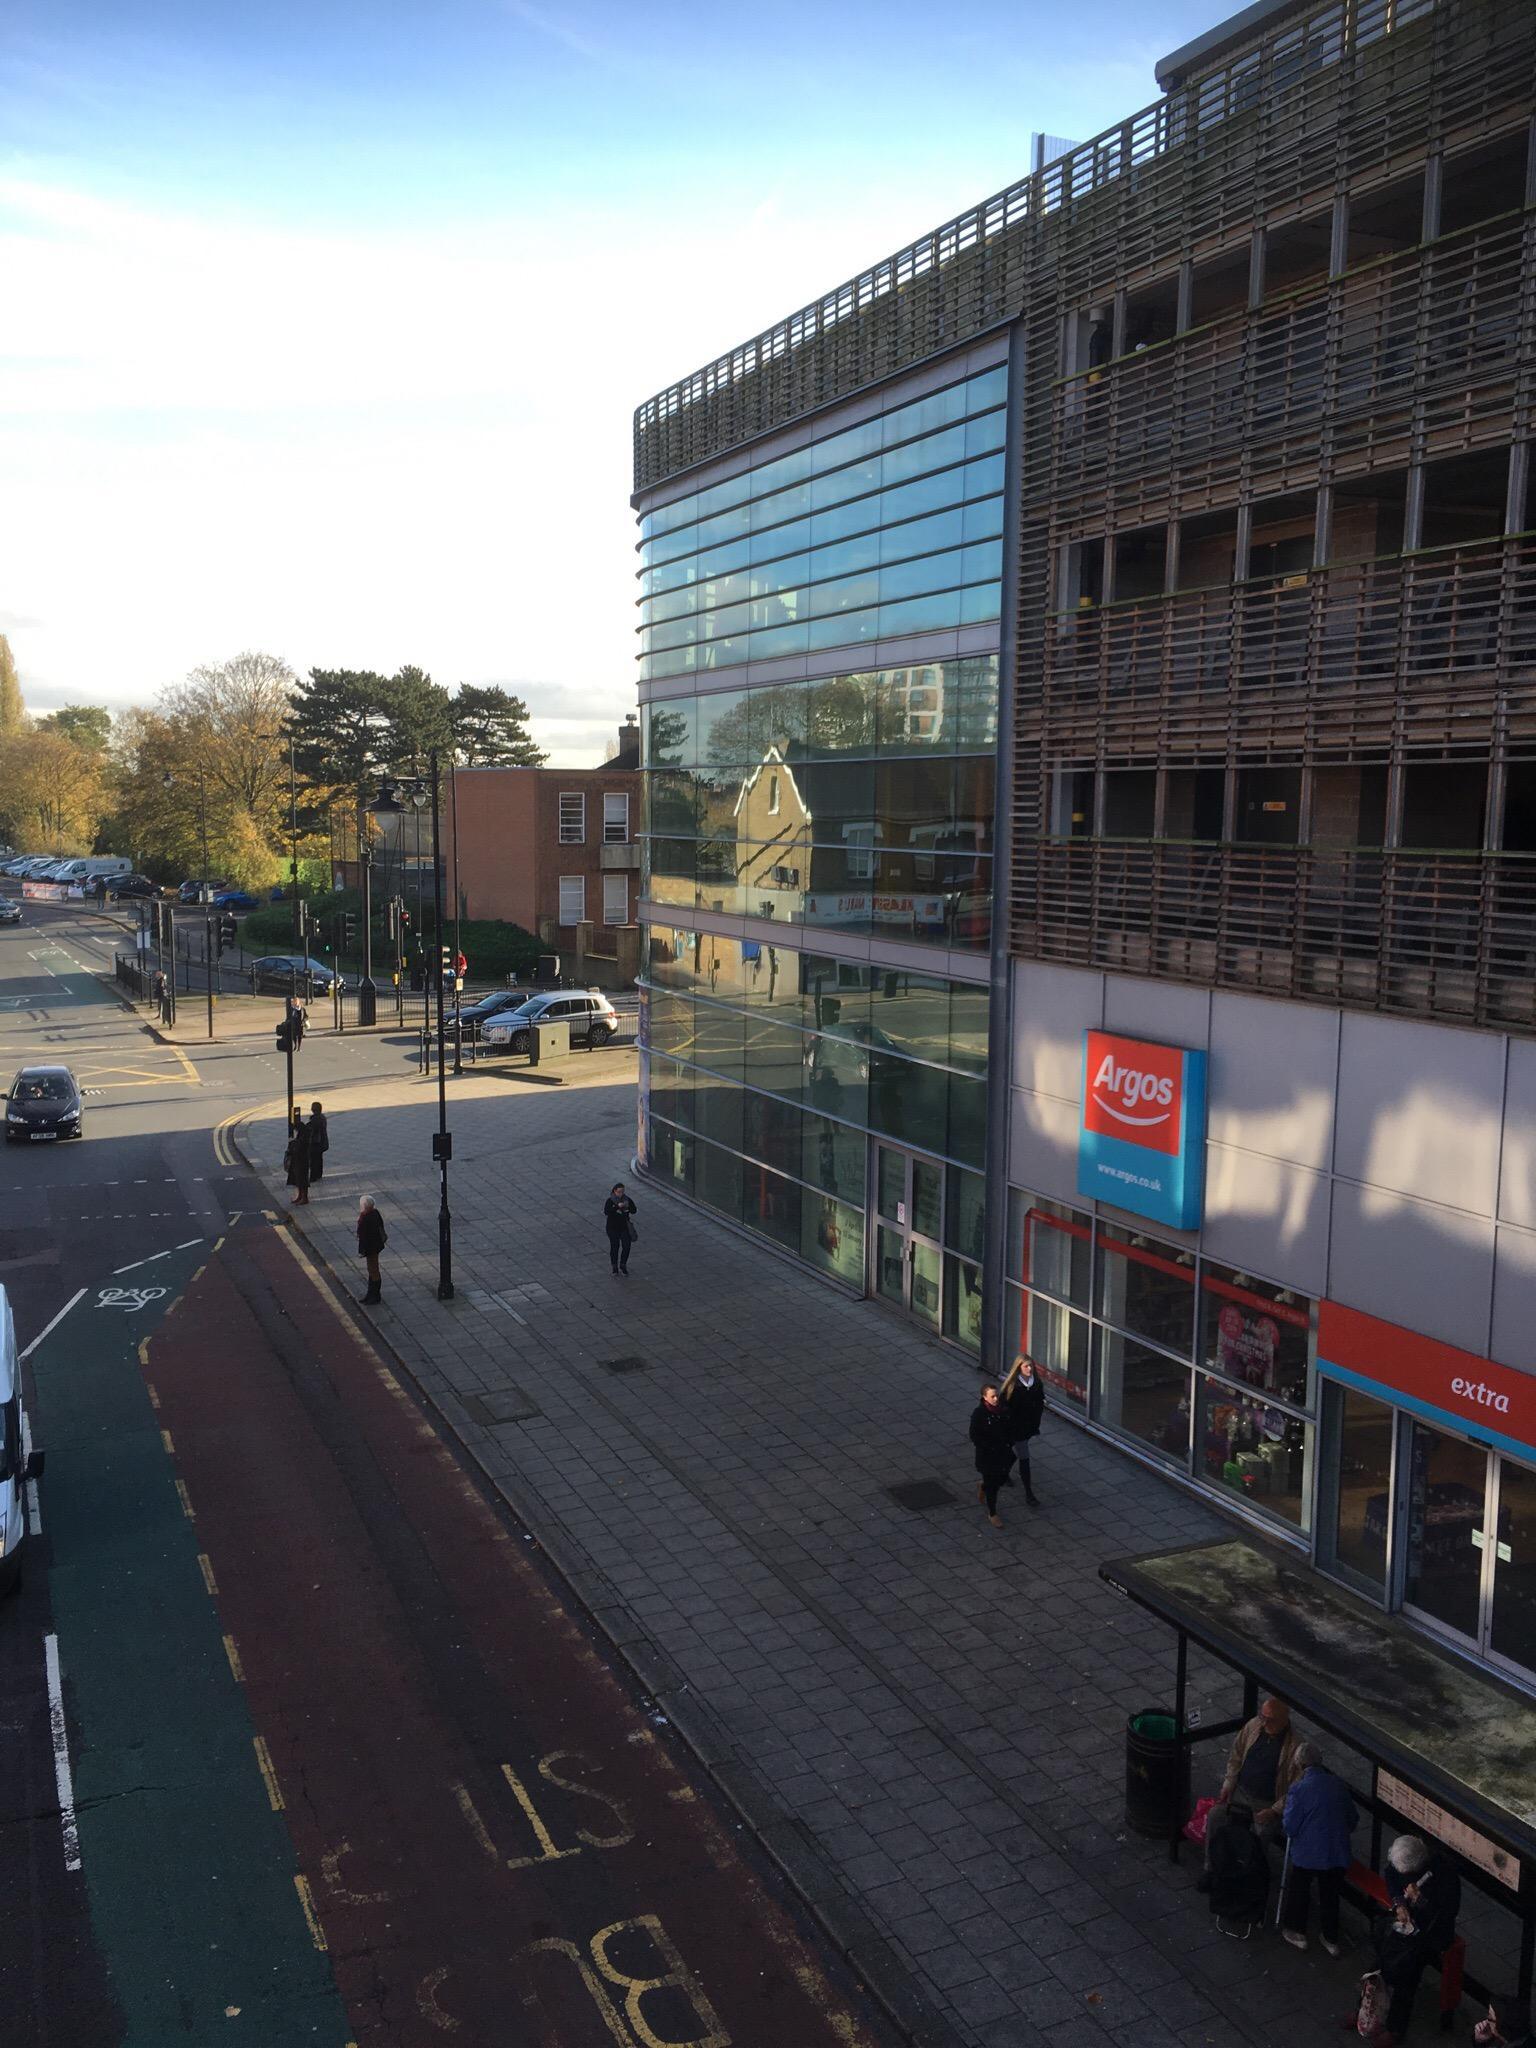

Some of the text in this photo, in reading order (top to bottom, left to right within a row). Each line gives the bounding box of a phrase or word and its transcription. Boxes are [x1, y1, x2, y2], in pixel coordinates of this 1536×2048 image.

[1093, 1055, 1174, 1108] Argos
[1097, 1163, 1162, 1192] www.argos.co.uk
[1451, 1377, 1511, 1413] extra
